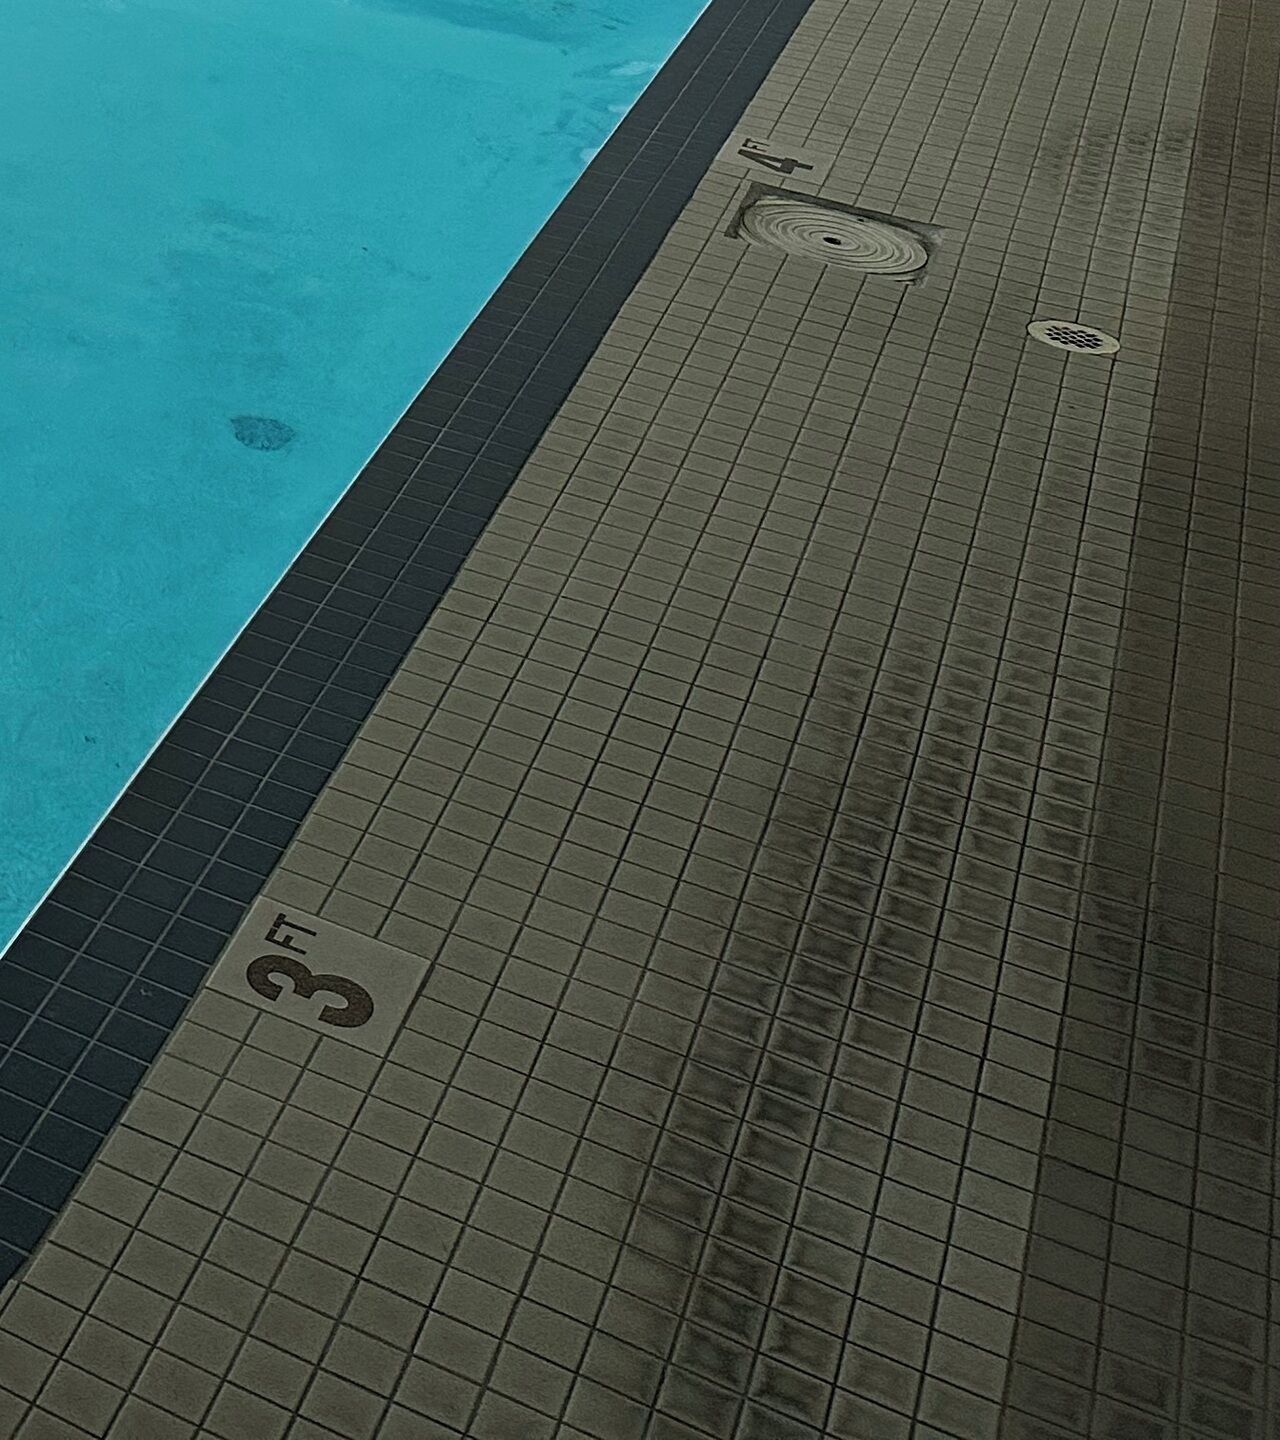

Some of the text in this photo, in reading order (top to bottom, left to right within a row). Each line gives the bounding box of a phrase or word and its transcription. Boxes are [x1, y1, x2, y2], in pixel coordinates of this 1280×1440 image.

[738, 138, 814, 175] 4 FT
[246, 912, 375, 1029] 3 FT
